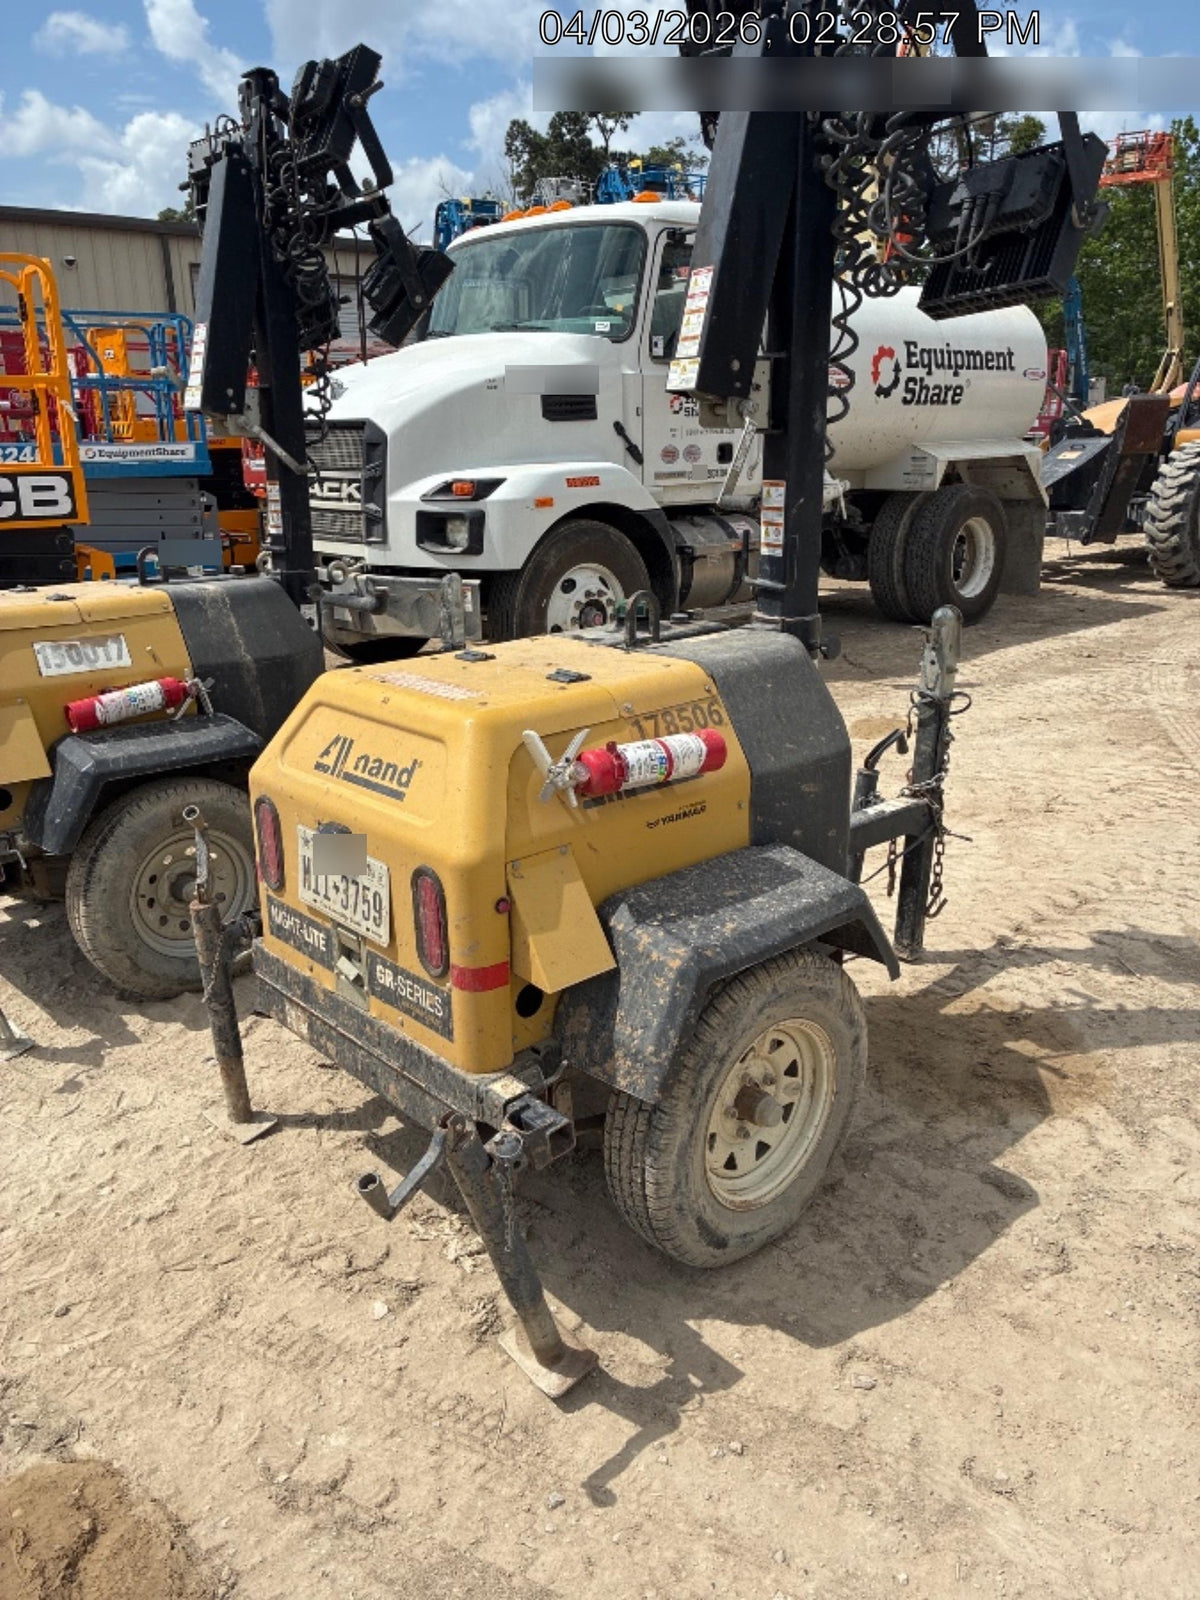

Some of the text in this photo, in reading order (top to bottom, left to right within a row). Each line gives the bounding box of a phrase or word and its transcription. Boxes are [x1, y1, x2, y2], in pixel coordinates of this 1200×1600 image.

[903, 340, 1016, 377] Equipment
[901, 376, 965, 406] Share
[98, 447, 187, 459] EquipmentShare
[309, 481, 361, 499] ACK
[631, 700, 724, 740] 178506
[375, 964, 444, 1018] GR-SERIES
